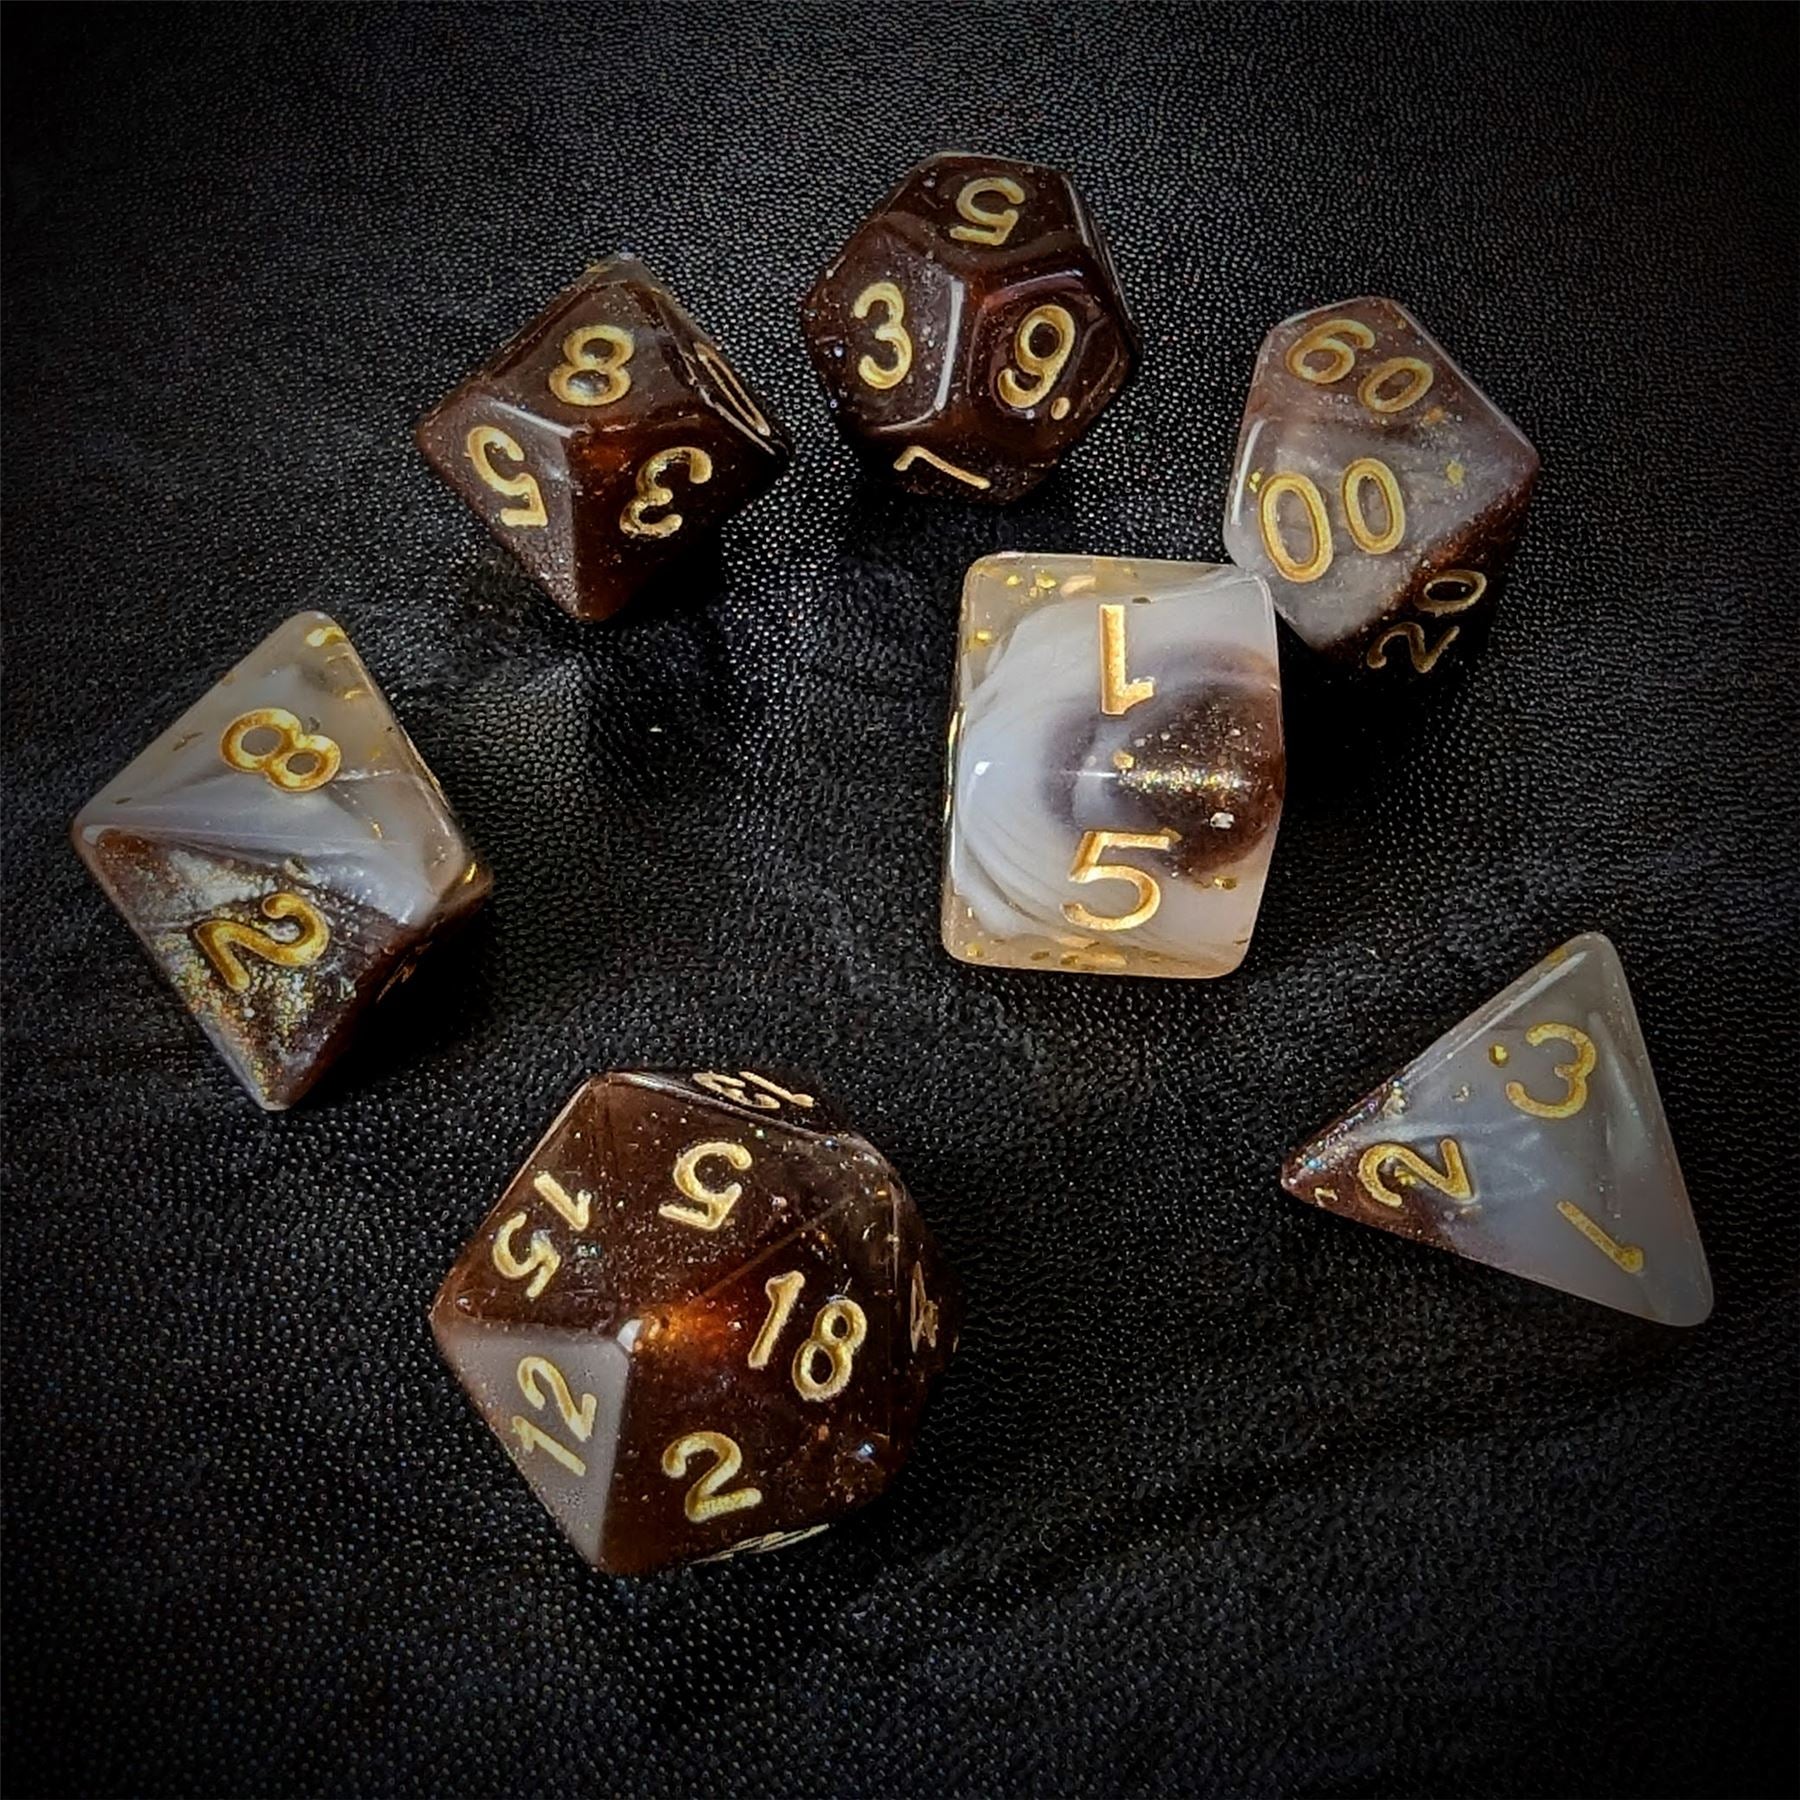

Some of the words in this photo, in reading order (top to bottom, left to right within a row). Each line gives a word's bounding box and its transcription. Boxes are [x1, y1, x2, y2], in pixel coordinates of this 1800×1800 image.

[950, 177, 1025, 246] 5
[548, 325, 635, 406] 8
[853, 281, 913, 390] 3
[1285, 319, 1434, 413] 60
[466, 426, 548, 528] 5
[619, 446, 713, 539] 3
[1258, 457, 1405, 583] 00
[1099, 604, 1154, 715] 1
[1366, 569, 1488, 673] 20
[219, 708, 342, 793] 8
[1060, 829, 1182, 932] 5
[192, 892, 330, 992] 2
[1505, 1023, 1596, 1120] 3
[658, 1141, 753, 1231] 5
[1357, 1137, 1478, 1209] 2
[492, 1171, 592, 1299] 15
[1556, 1200, 1645, 1274] 1
[748, 1270, 868, 1401] 18
[511, 1356, 598, 1477] 12
[662, 1431, 763, 1523] 2
